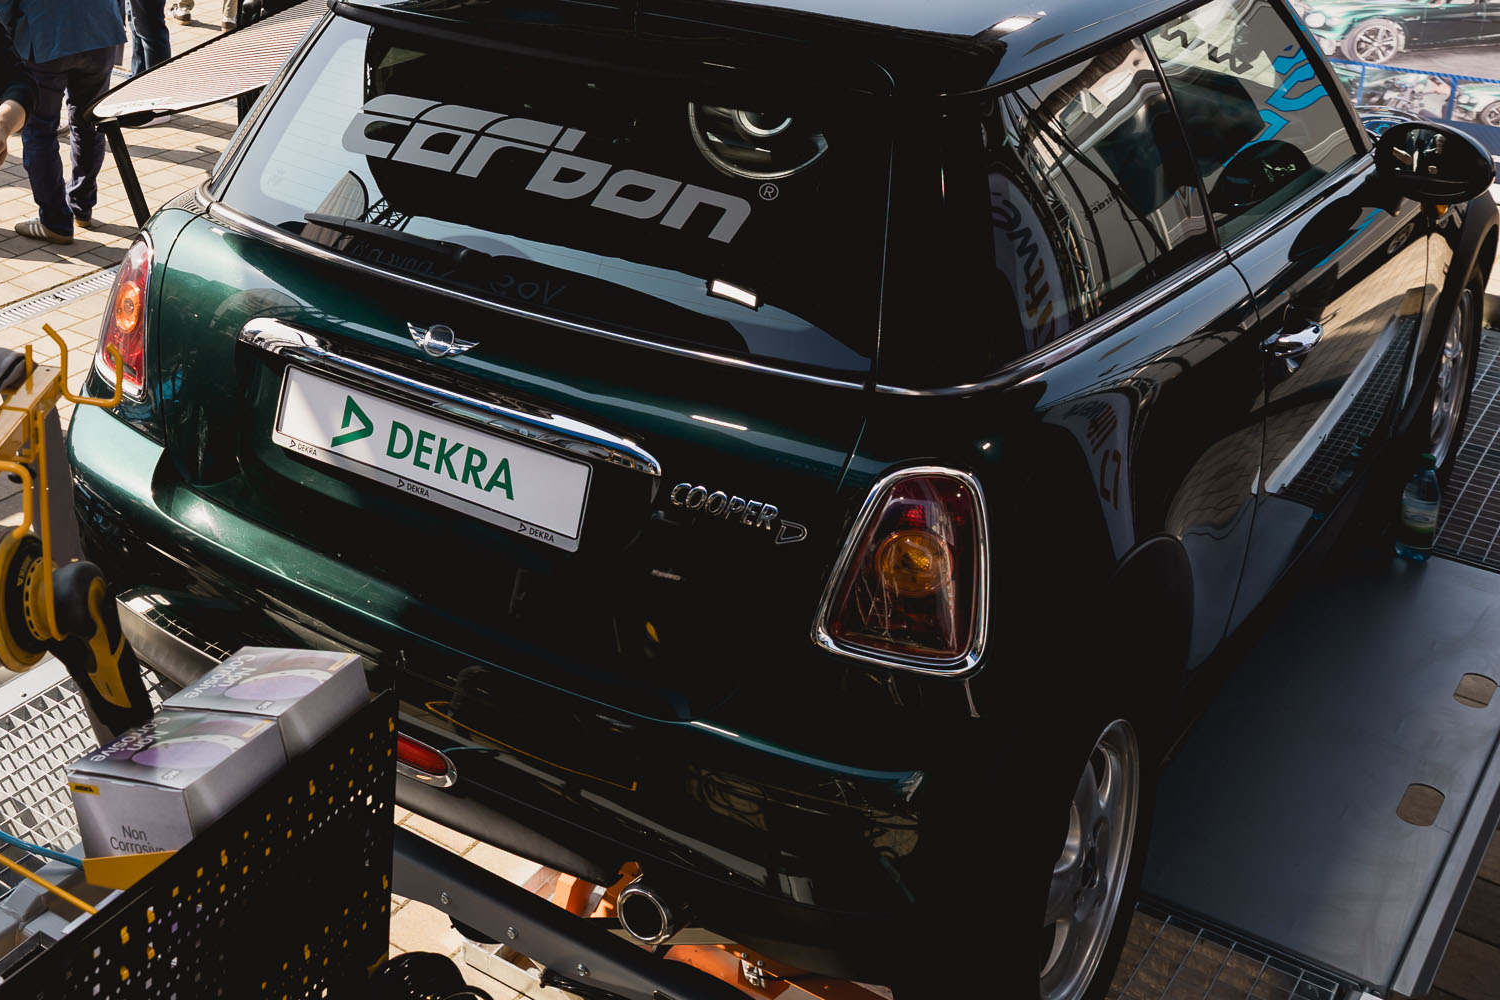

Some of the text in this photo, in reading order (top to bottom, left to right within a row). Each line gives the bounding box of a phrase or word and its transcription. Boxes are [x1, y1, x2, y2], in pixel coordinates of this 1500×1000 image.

[341, 93, 752, 244] carbon
[297, 442, 318, 457] DEKRA
[386, 420, 515, 501] DEKRA
[406, 482, 430, 499] DEKRA
[670, 482, 808, 545] COOPER D
[528, 526, 555, 544] DEKRA
[121, 825, 148, 842] Non
